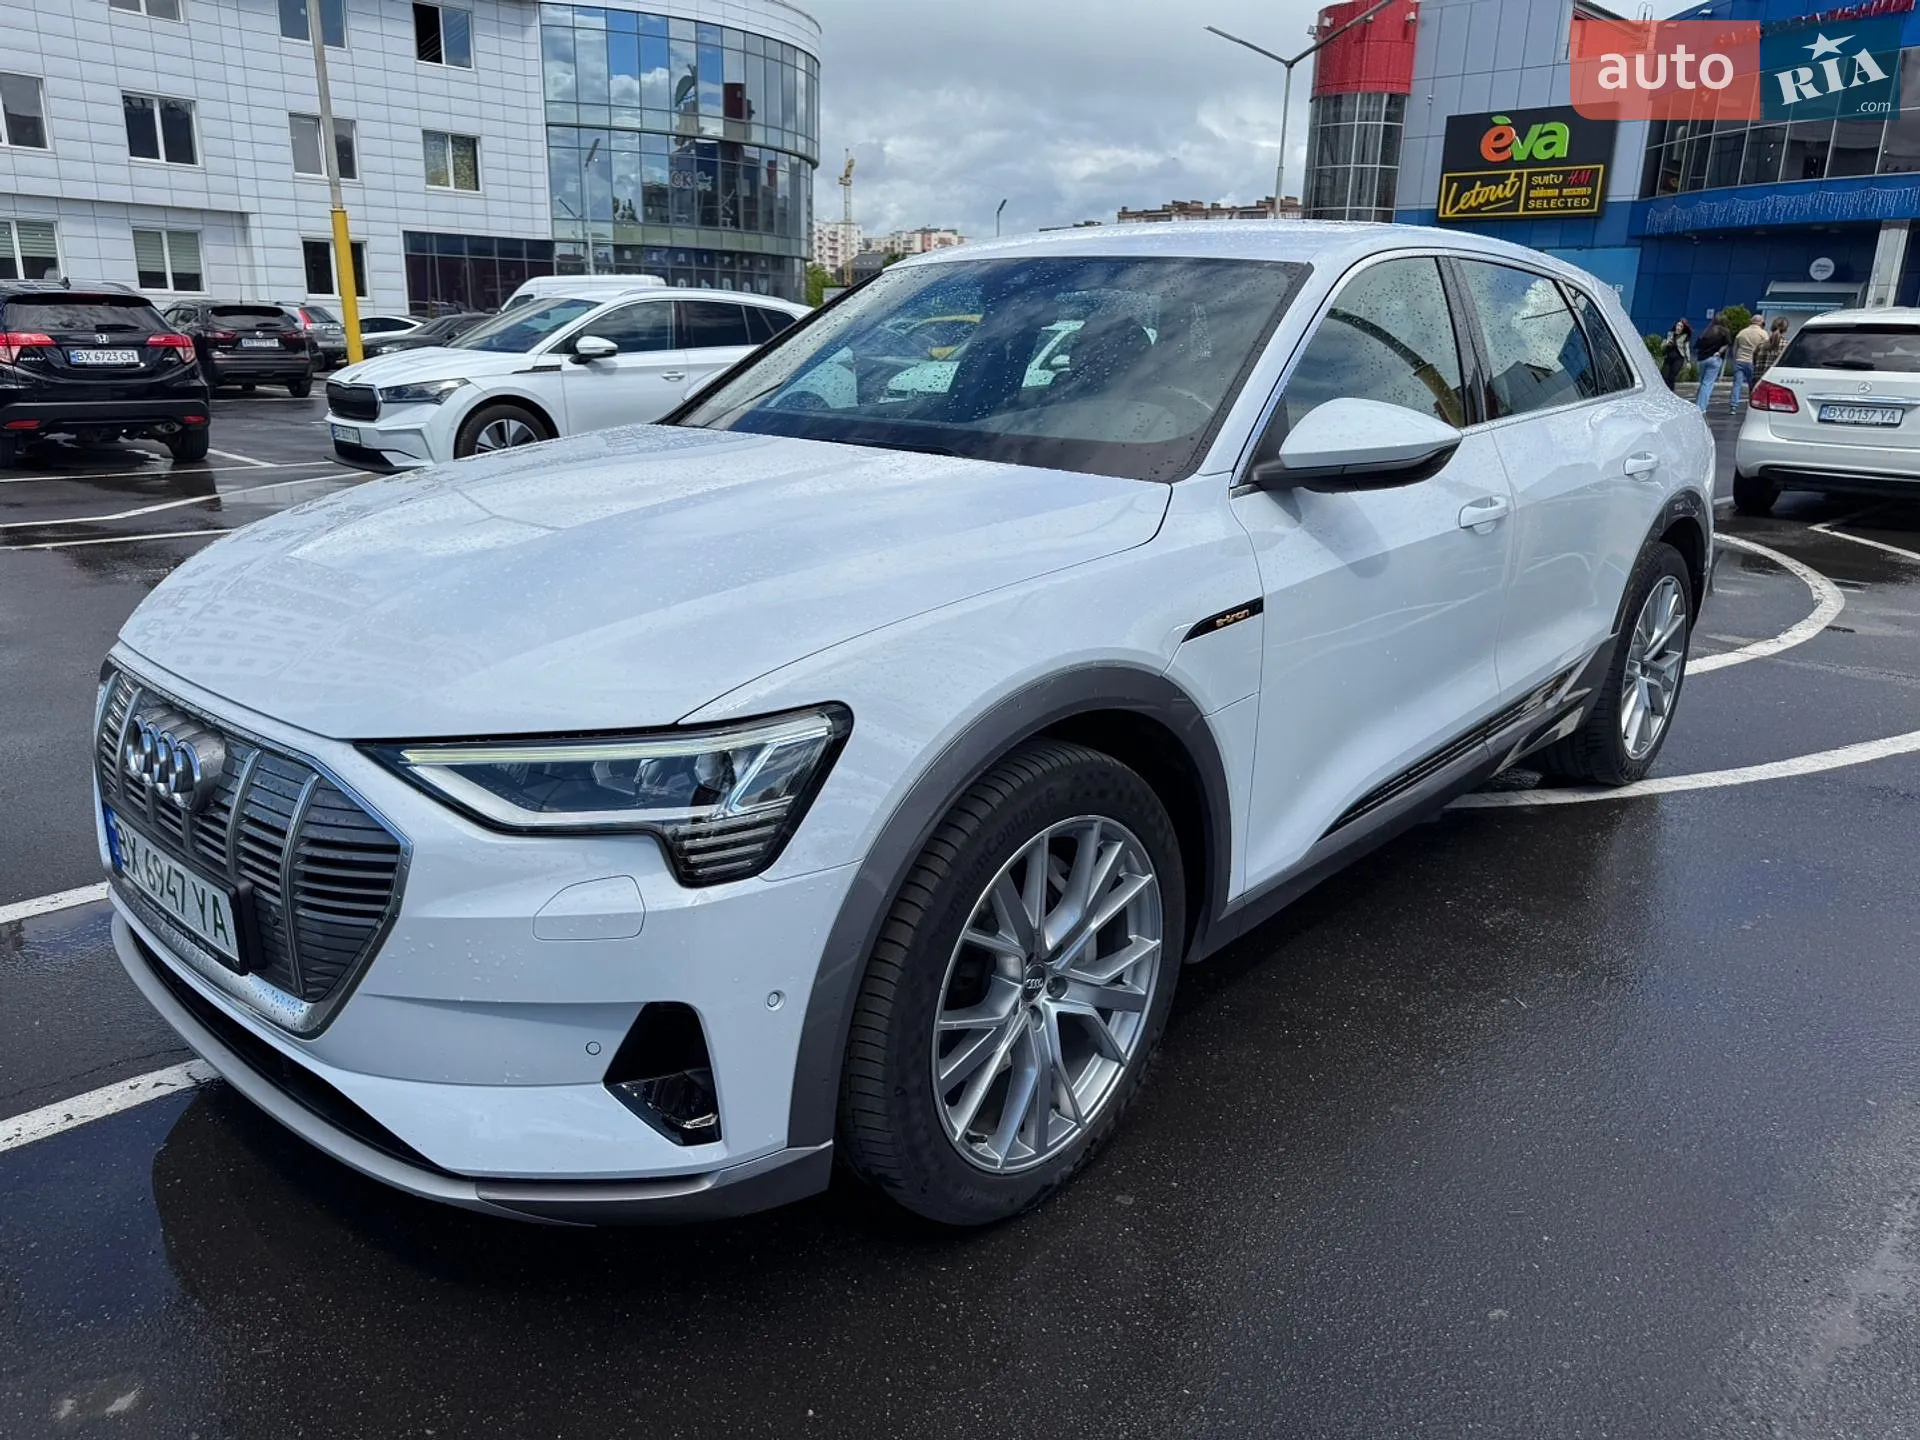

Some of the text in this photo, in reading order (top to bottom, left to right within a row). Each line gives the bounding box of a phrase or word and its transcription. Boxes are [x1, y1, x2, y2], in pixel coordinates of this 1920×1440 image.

[1446, 172, 1521, 215] Letout
[1528, 197, 1590, 209] SELECTED
[76, 351, 136, 361] BX 6723 CH
[1827, 406, 1897, 422] BX 0137 YA
[145, 848, 187, 916] 6947
[191, 881, 230, 947] YA
